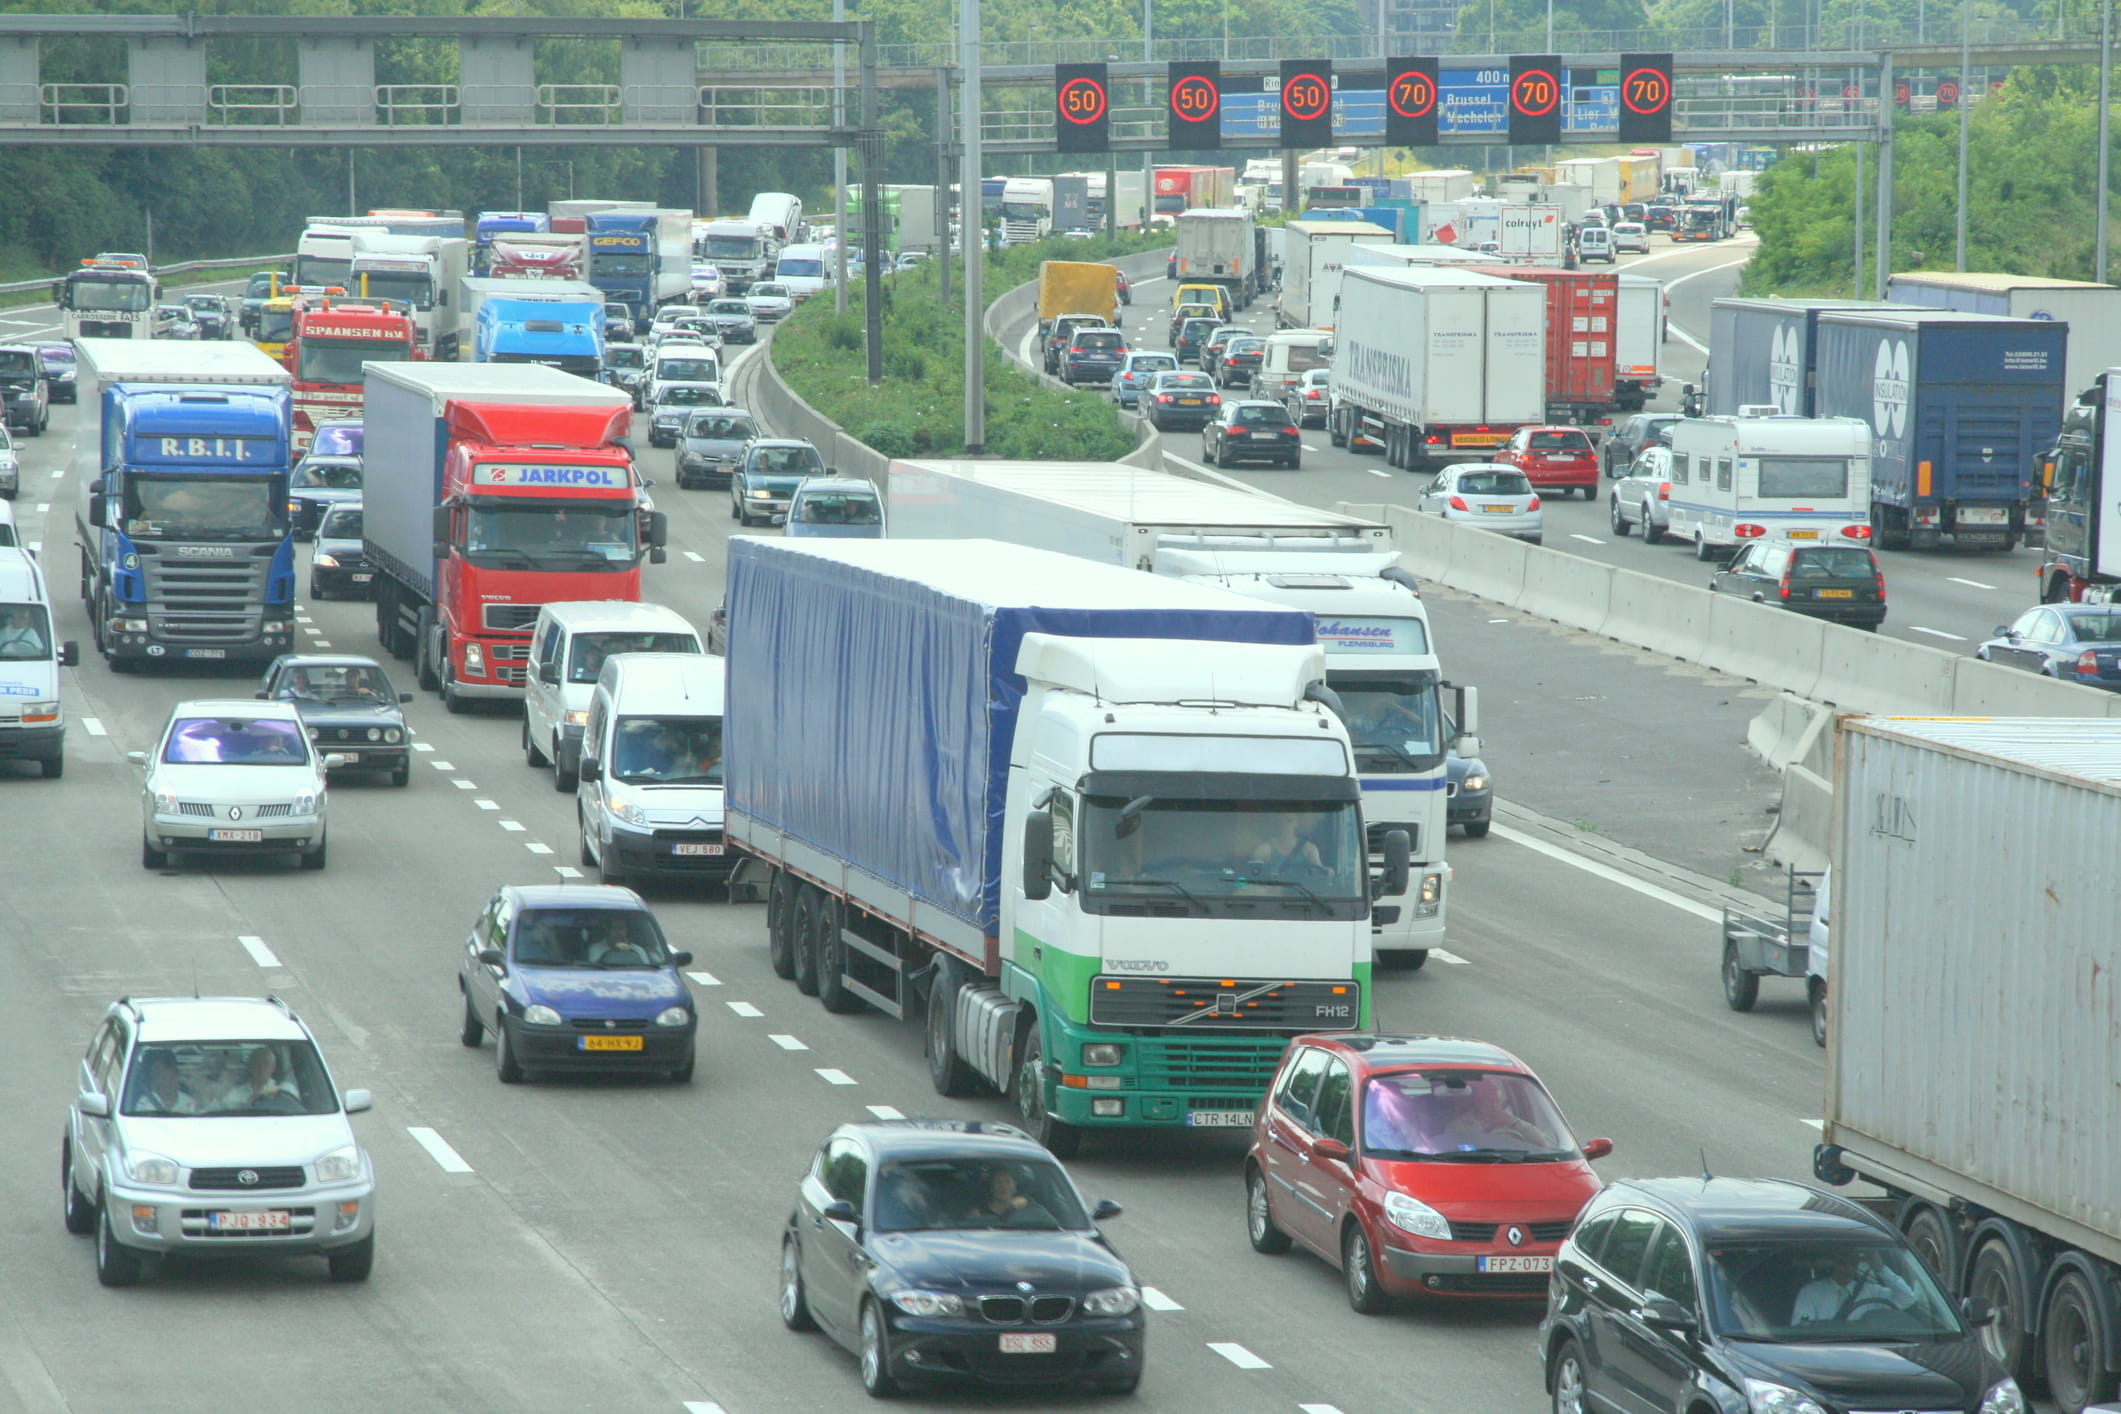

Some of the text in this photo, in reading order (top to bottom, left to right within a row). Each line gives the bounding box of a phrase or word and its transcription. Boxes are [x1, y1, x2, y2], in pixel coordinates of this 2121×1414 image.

[1475, 70, 1500, 83] 400
[1293, 86, 1320, 107] 50
[1399, 84, 1426, 105] 70
[1522, 82, 1549, 104] 70
[1633, 80, 1659, 102] 70
[1069, 90, 1096, 111] 50
[1181, 88, 1208, 109] 50
[1447, 93, 1491, 105] Brussel
[1447, 110, 1502, 124] Mechelen
[1578, 107, 1600, 121] Lier
[1506, 218, 1542, 230] colruyt
[593, 237, 640, 247] GEFCO
[306, 326, 381, 338] SPAANSEN
[1349, 339, 1411, 399] TRANSPRISMA
[518, 468, 613, 485] JARKPOL
[178, 546, 233, 557] SCANIA
[126, 555, 135, 567] 4
[151, 645, 161, 654] LT
[1338, 641, 1395, 649] FLENSBURG
[680, 845, 698, 854] VEJ
[1106, 959, 1169, 972] VOLVO
[1315, 1005, 1349, 1018] FH12
[1194, 1112, 1219, 1126] CTR
[1490, 1257, 1550, 1271] FPZ-073
